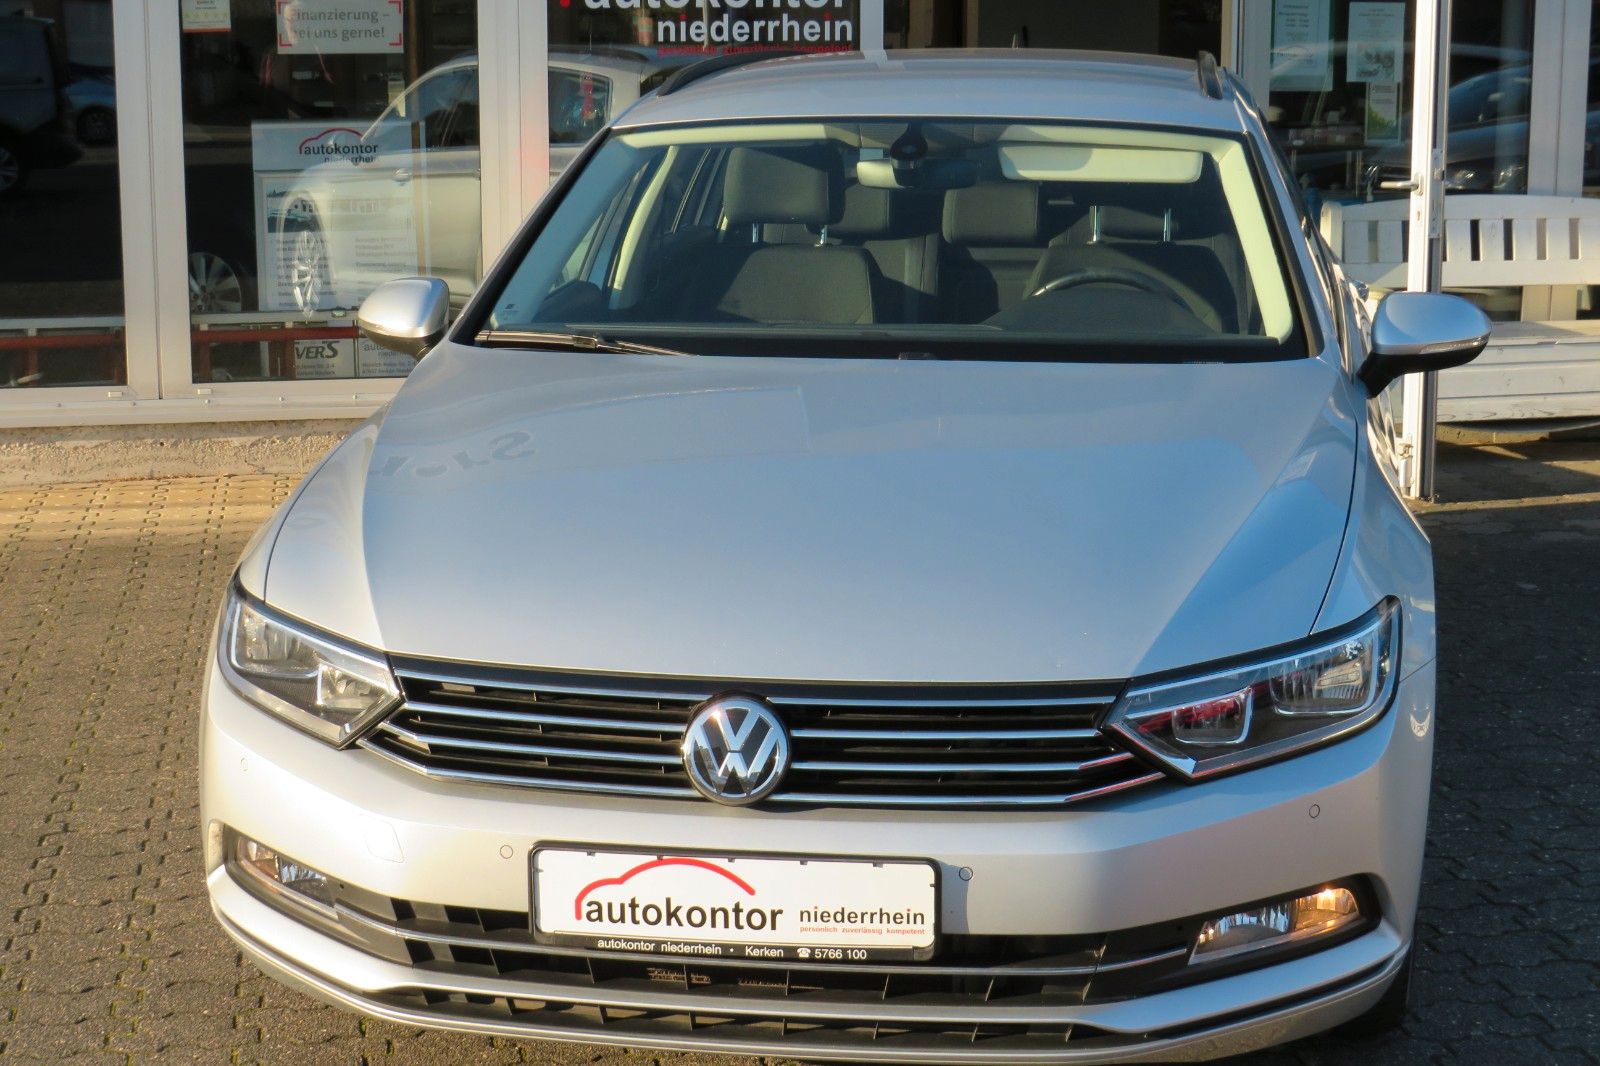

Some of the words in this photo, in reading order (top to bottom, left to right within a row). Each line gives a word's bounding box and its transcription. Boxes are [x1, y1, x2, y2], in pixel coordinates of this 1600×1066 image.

[315, 29, 338, 39] uns
[341, 27, 385, 42] gerne!
[657, 13, 852, 42] niederrhein
[304, 143, 378, 155] autokontor
[586, 896, 783, 931] autokontor
[800, 906, 925, 925] niederrhein
[800, 926, 838, 934] persönlich
[842, 926, 883, 936] zuverlässig
[886, 927, 926, 936] kompetent
[597, 938, 655, 951] autokontor
[661, 940, 722, 955] niederrhein
[745, 945, 784, 958] Kerken
[814, 948, 843, 959] 5766
[846, 949, 867, 960] 100
